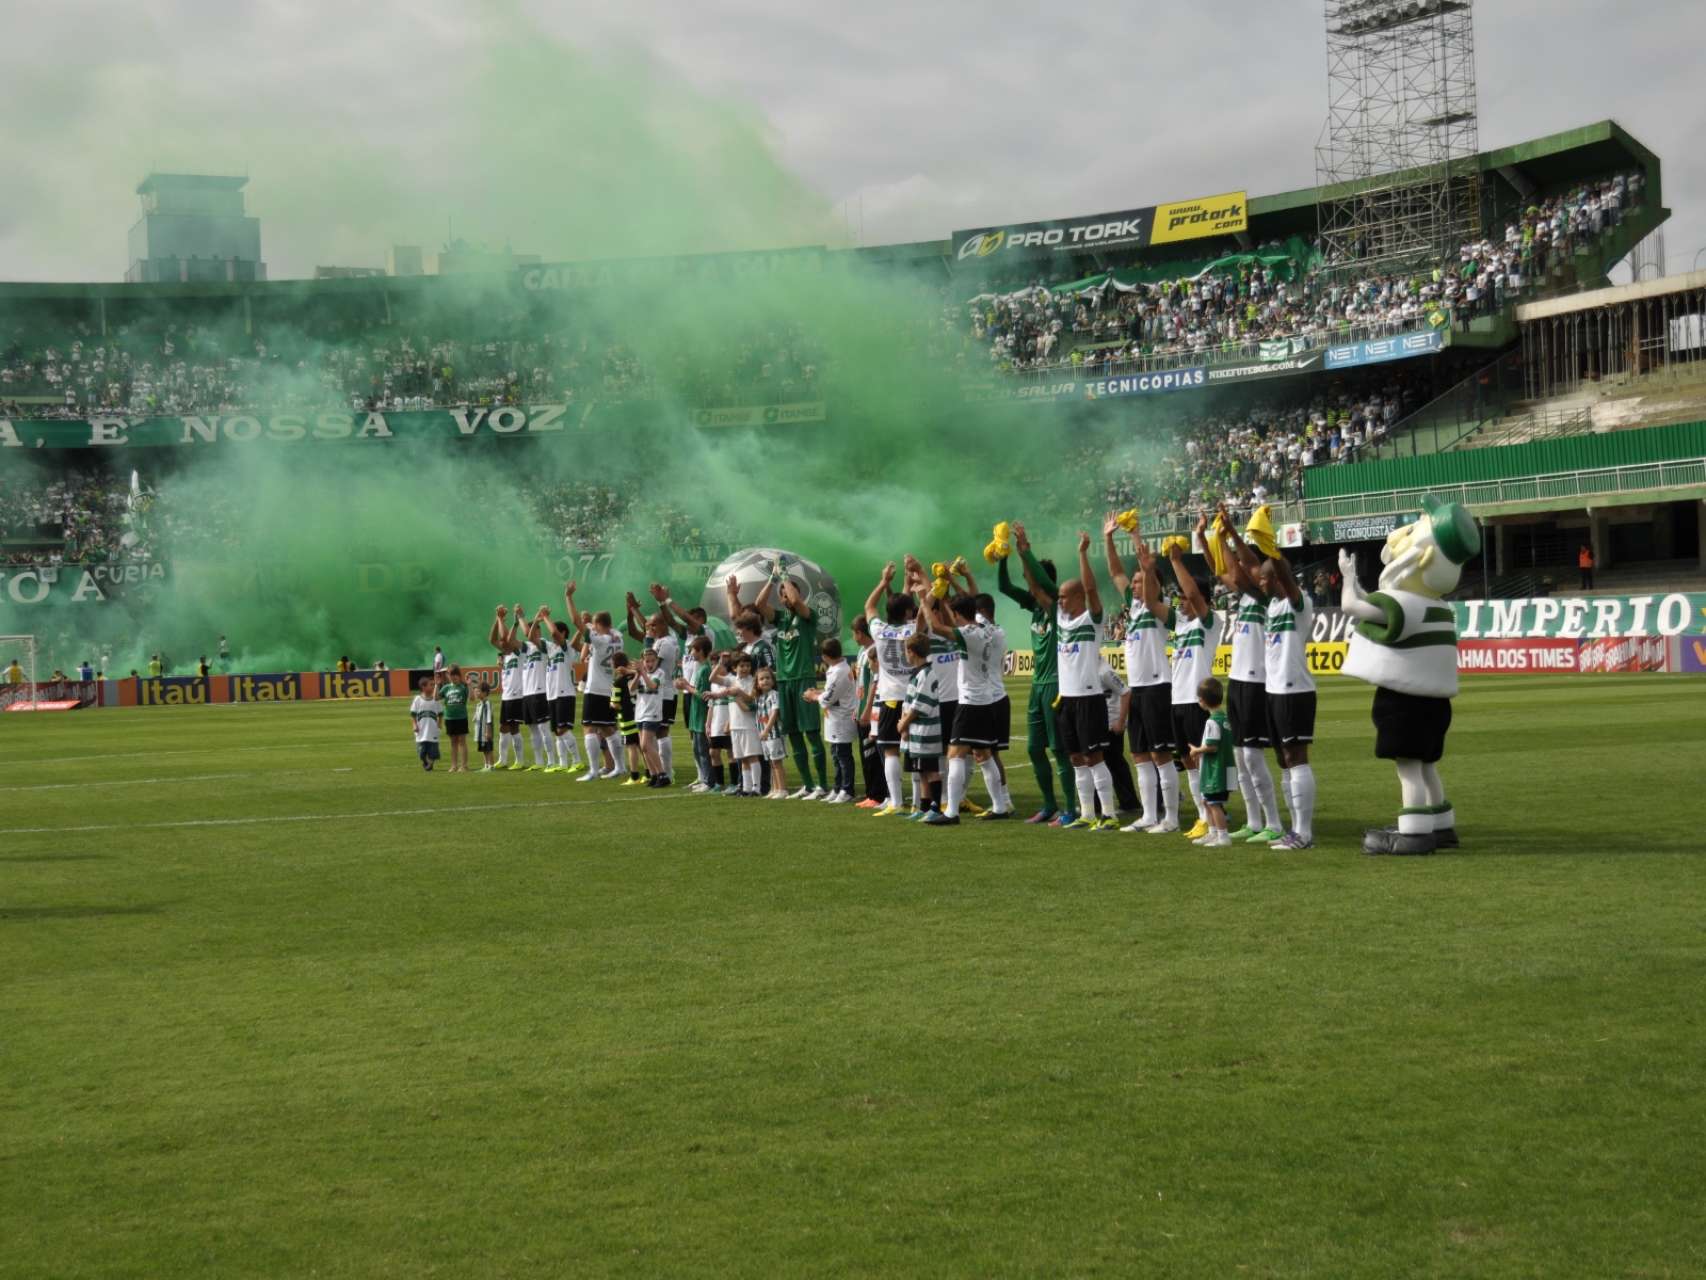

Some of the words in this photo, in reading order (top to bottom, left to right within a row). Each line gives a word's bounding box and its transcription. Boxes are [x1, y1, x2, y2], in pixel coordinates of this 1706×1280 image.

[1168, 204, 1242, 230] protork
[1212, 219, 1243, 231] .com
[1006, 229, 1064, 249] PRO
[1069, 217, 1142, 242] TORK
[1365, 340, 1396, 354] NET
[1403, 332, 1436, 348] NET
[1329, 347, 1359, 361] NET
[179, 411, 393, 443] NOSSA
[1334, 528, 1346, 540] EM
[1496, 648, 1527, 668] DOS
[1531, 647, 1575, 668] TIMES
[142, 678, 206, 705] Itaú
[232, 675, 297, 703] Itaú
[324, 671, 387, 699] Itaú
